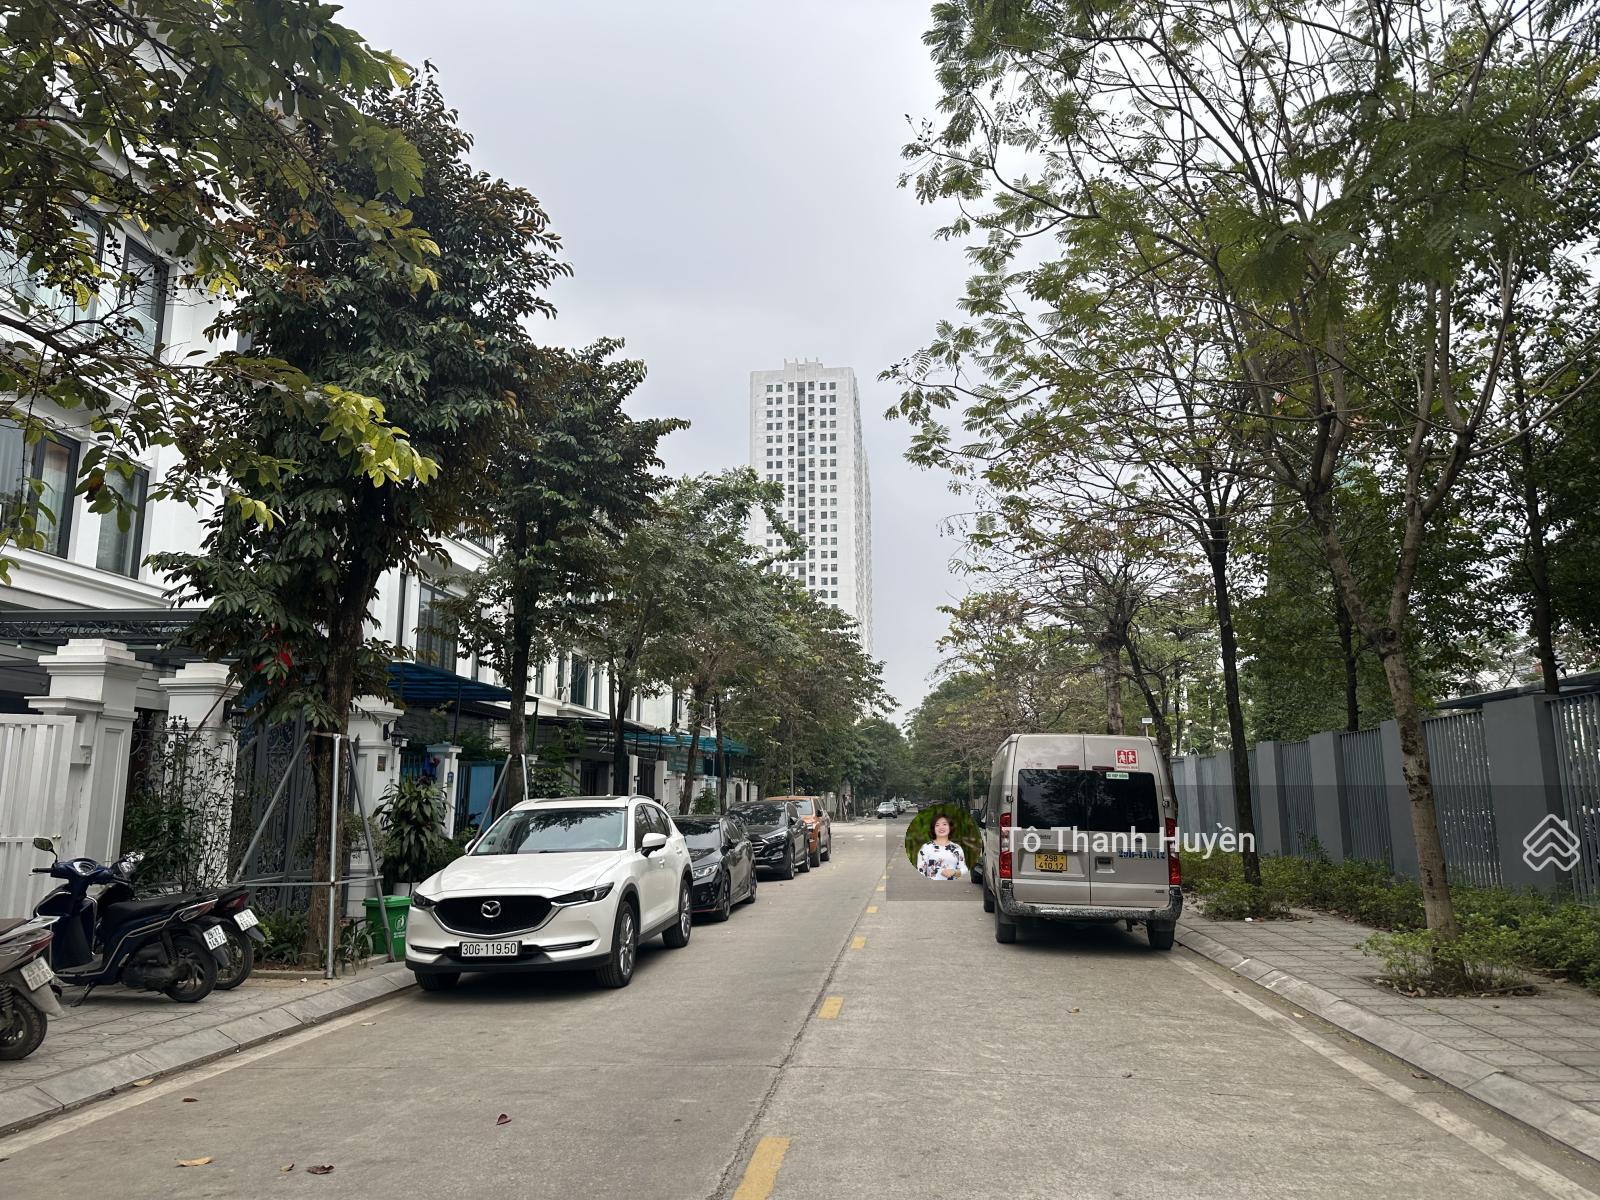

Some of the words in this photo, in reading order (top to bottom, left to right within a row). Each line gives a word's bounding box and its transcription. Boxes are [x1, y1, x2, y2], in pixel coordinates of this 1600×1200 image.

[1043, 854, 1058, 862] 29B
[1038, 862, 1064, 870] 410.12
[462, 943, 517, 955] 30G-119.50
